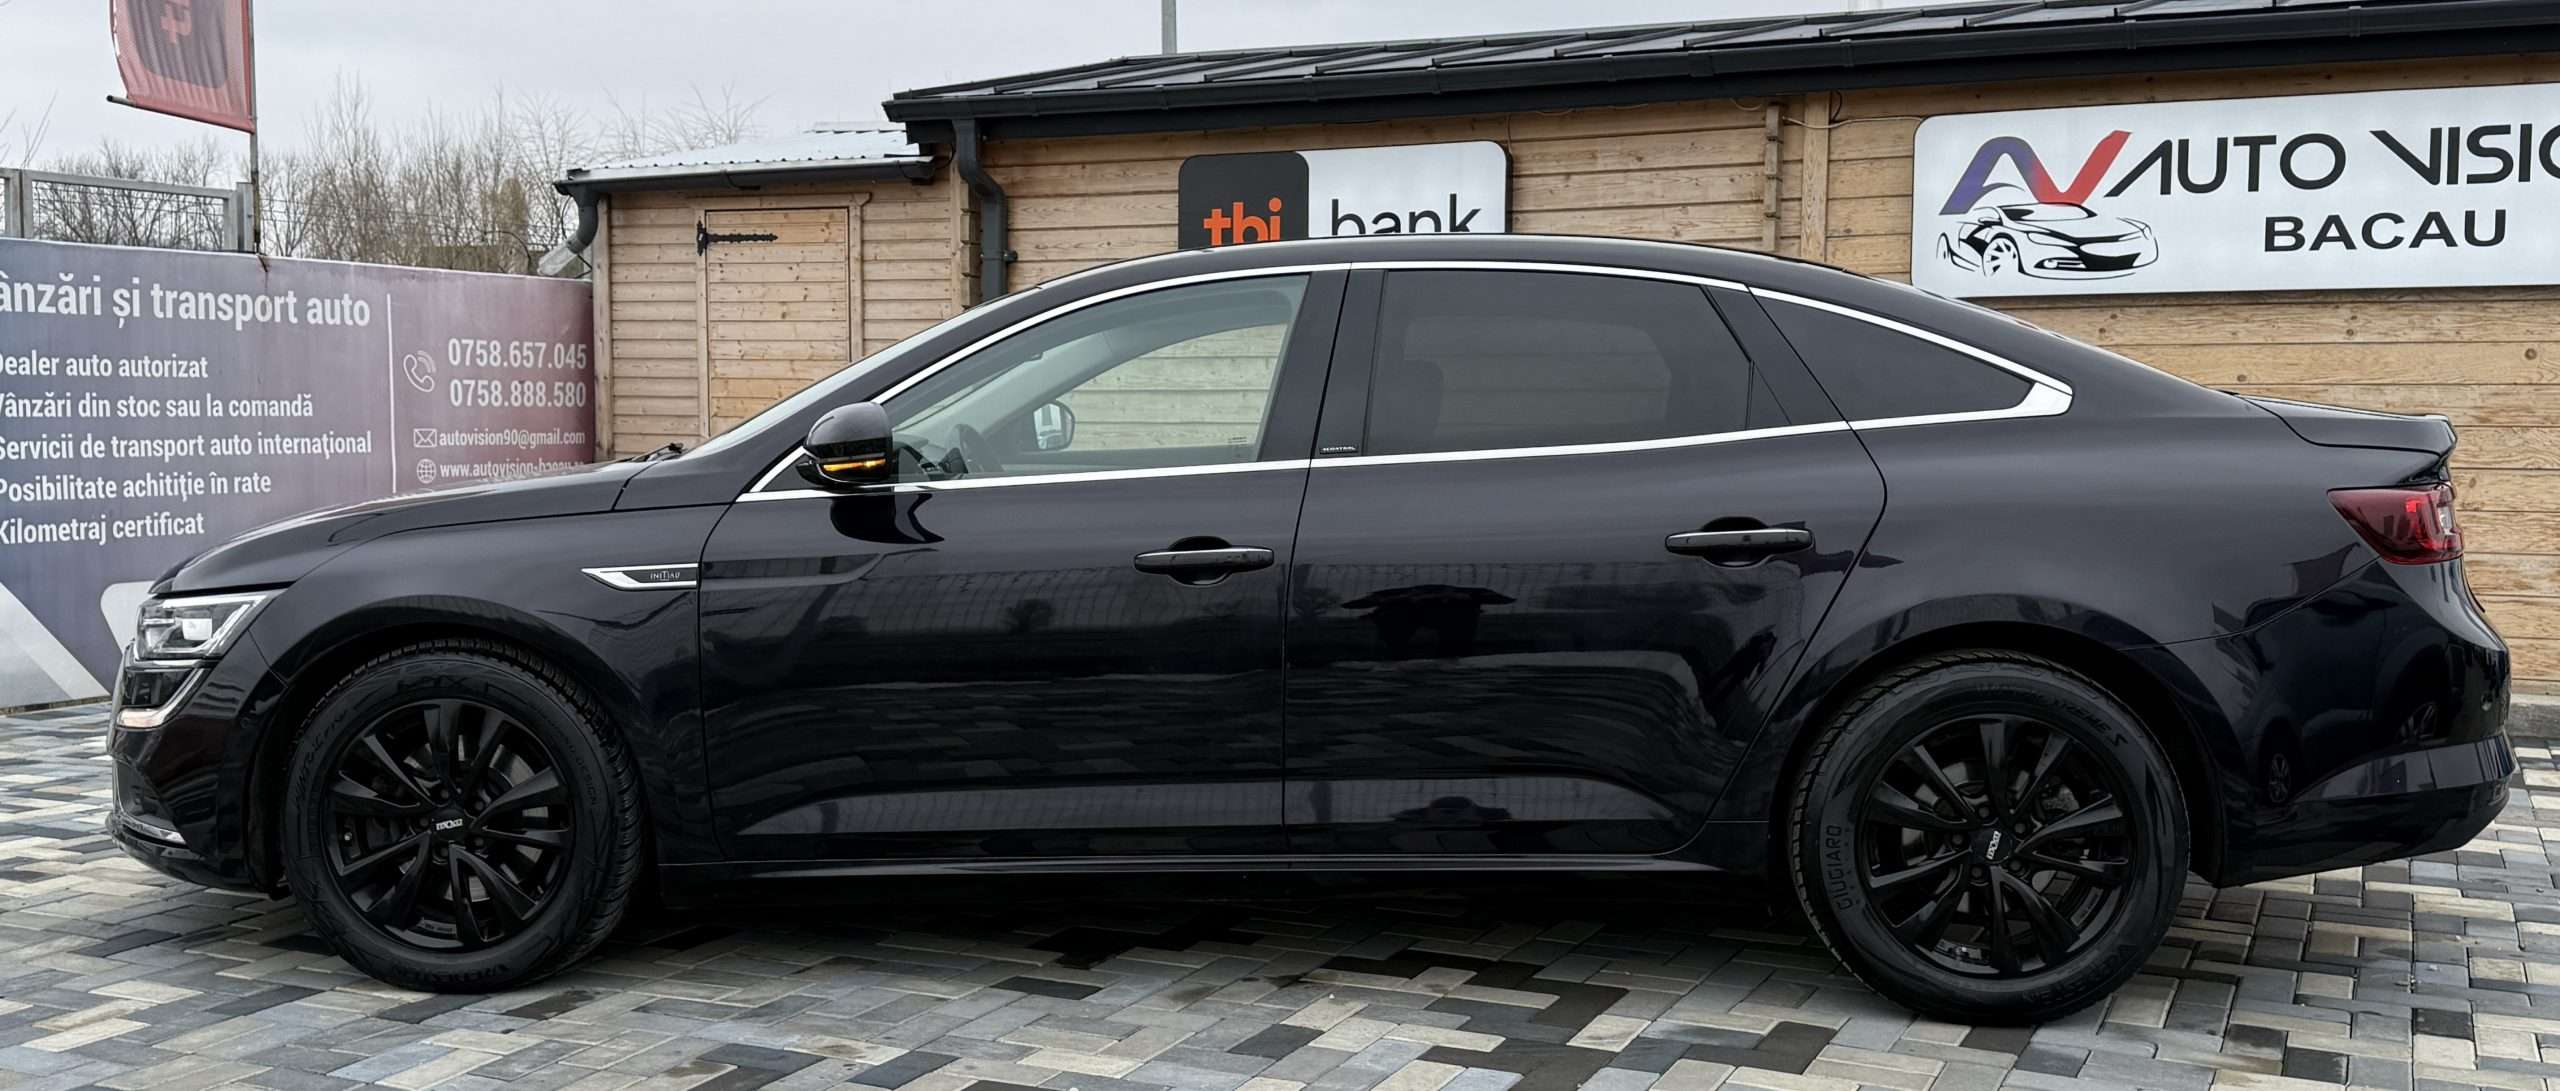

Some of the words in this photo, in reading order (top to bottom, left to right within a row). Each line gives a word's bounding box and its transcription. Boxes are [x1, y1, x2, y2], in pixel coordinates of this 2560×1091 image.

[2104, 133, 2346, 197] AUTO
[1203, 197, 1282, 246] tbi
[2263, 209, 2507, 252] BACAU
[112, 276, 141, 328] și
[151, 282, 299, 331] transport
[306, 293, 371, 327] auto
[0, 349, 60, 377] ealer
[65, 353, 113, 377] auto
[118, 353, 208, 378] autorizat
[448, 338, 587, 369] 0758.657.045
[78, 392, 111, 417] din
[116, 394, 161, 418] stoc
[166, 398, 200, 417] sau
[206, 393, 224, 417] la
[228, 393, 314, 417] comandă
[449, 378, 587, 408] 0758.888.580
[80, 432, 105, 459] de
[111, 435, 205, 462] transport
[210, 433, 252, 456] auto
[439, 427, 586, 450] autovision90@gmail.com
[210, 471, 228, 496] în
[234, 472, 272, 494] rate
[113, 511, 205, 540] certificat
